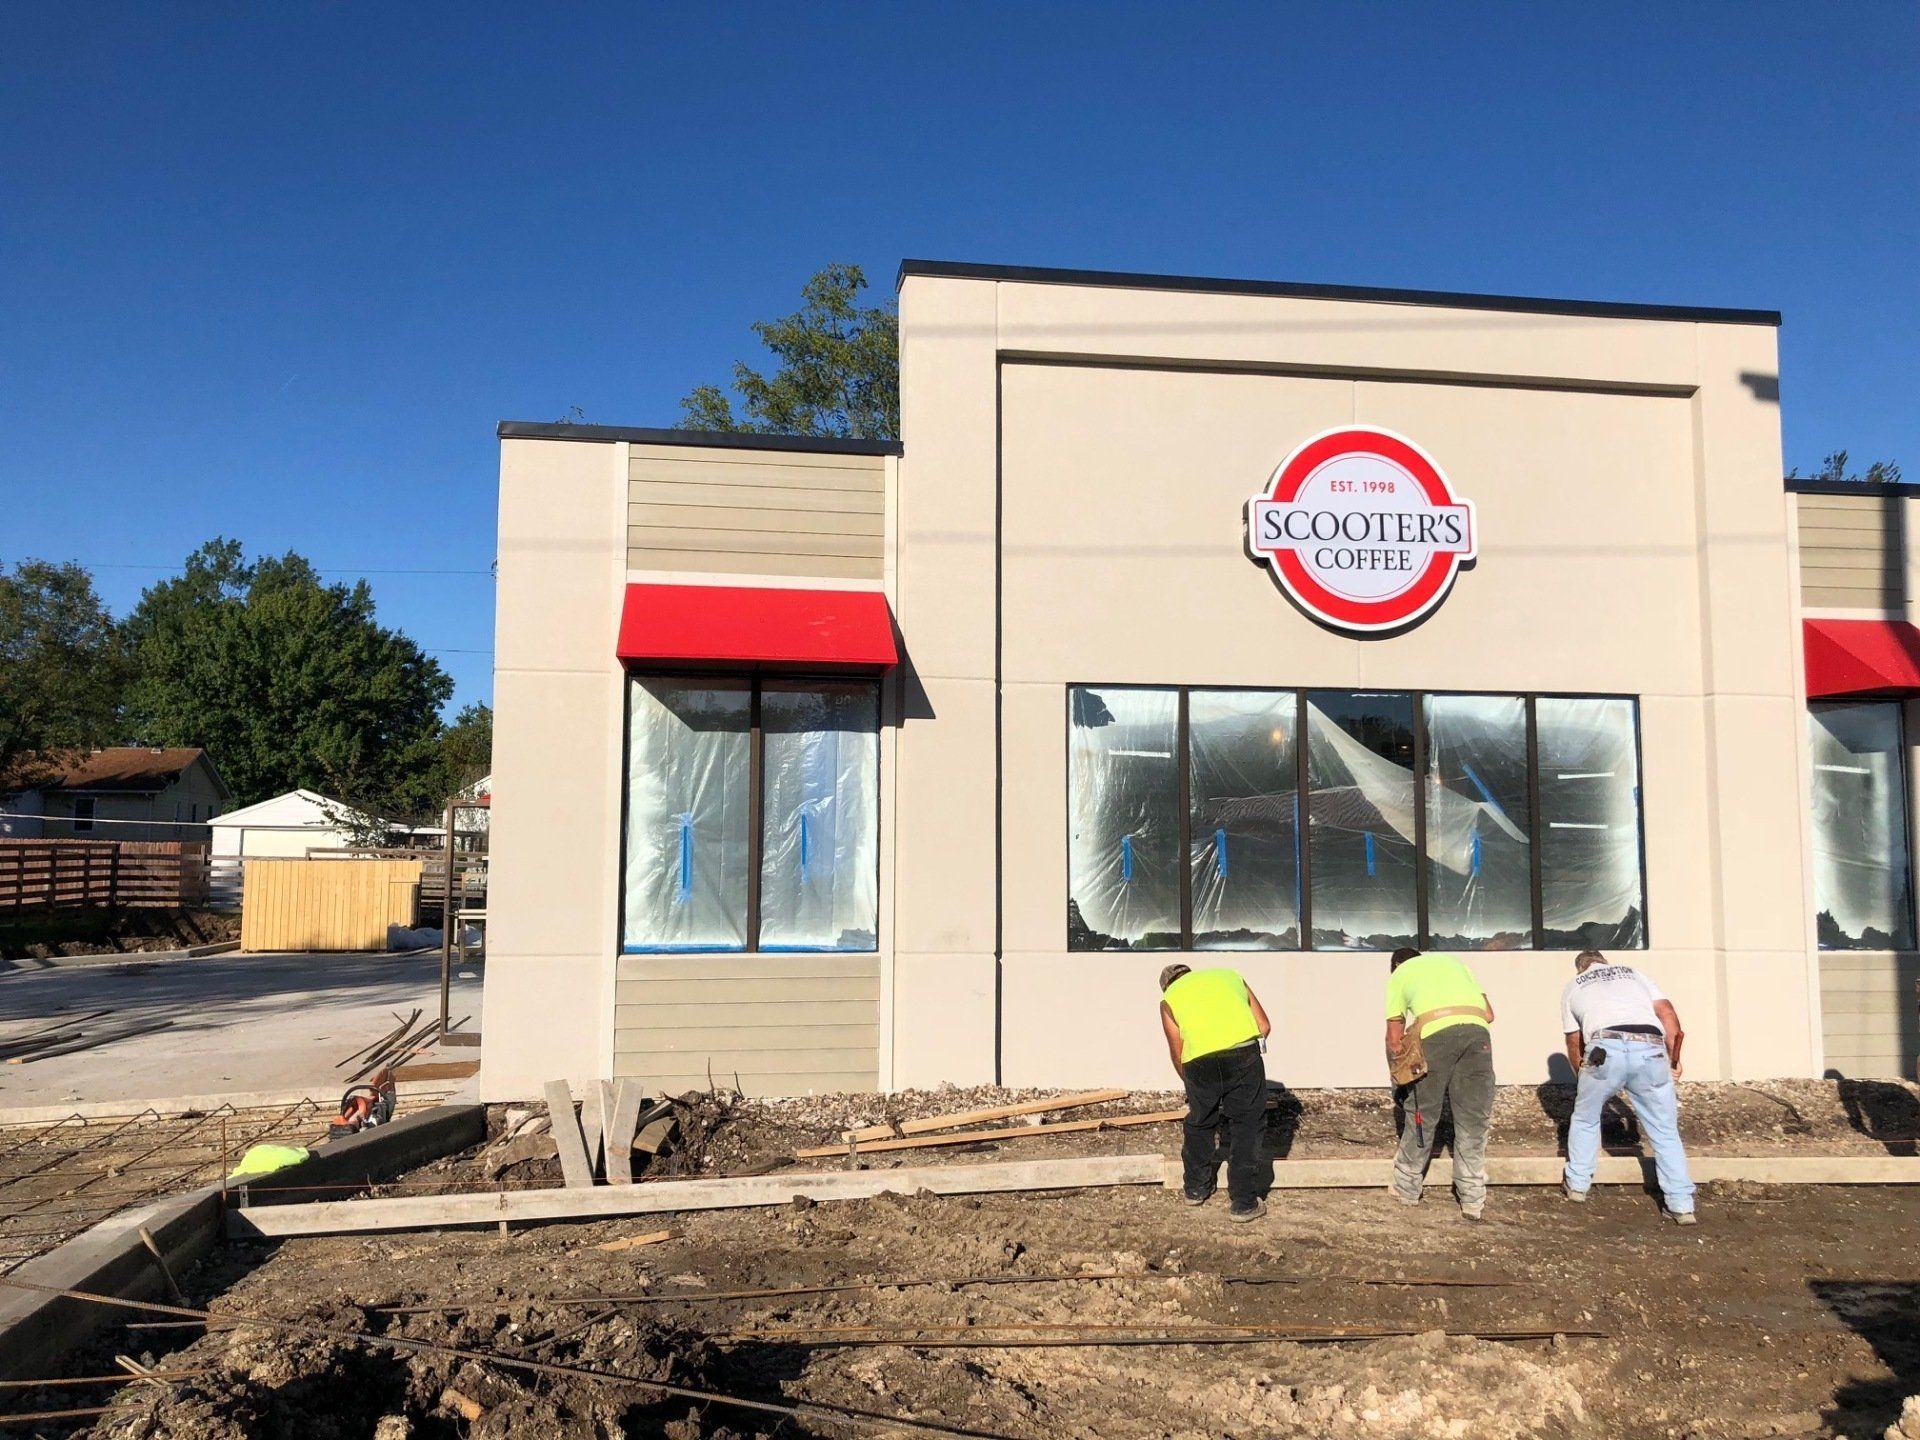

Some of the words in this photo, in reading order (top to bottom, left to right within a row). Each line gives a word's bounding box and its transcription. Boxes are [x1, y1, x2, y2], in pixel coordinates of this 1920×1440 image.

[1330, 480, 1358, 493] EST.
[1363, 481, 1396, 494] 1998
[1264, 509, 1462, 544] SCOOTER'S
[1315, 548, 1413, 571] COFFEE
